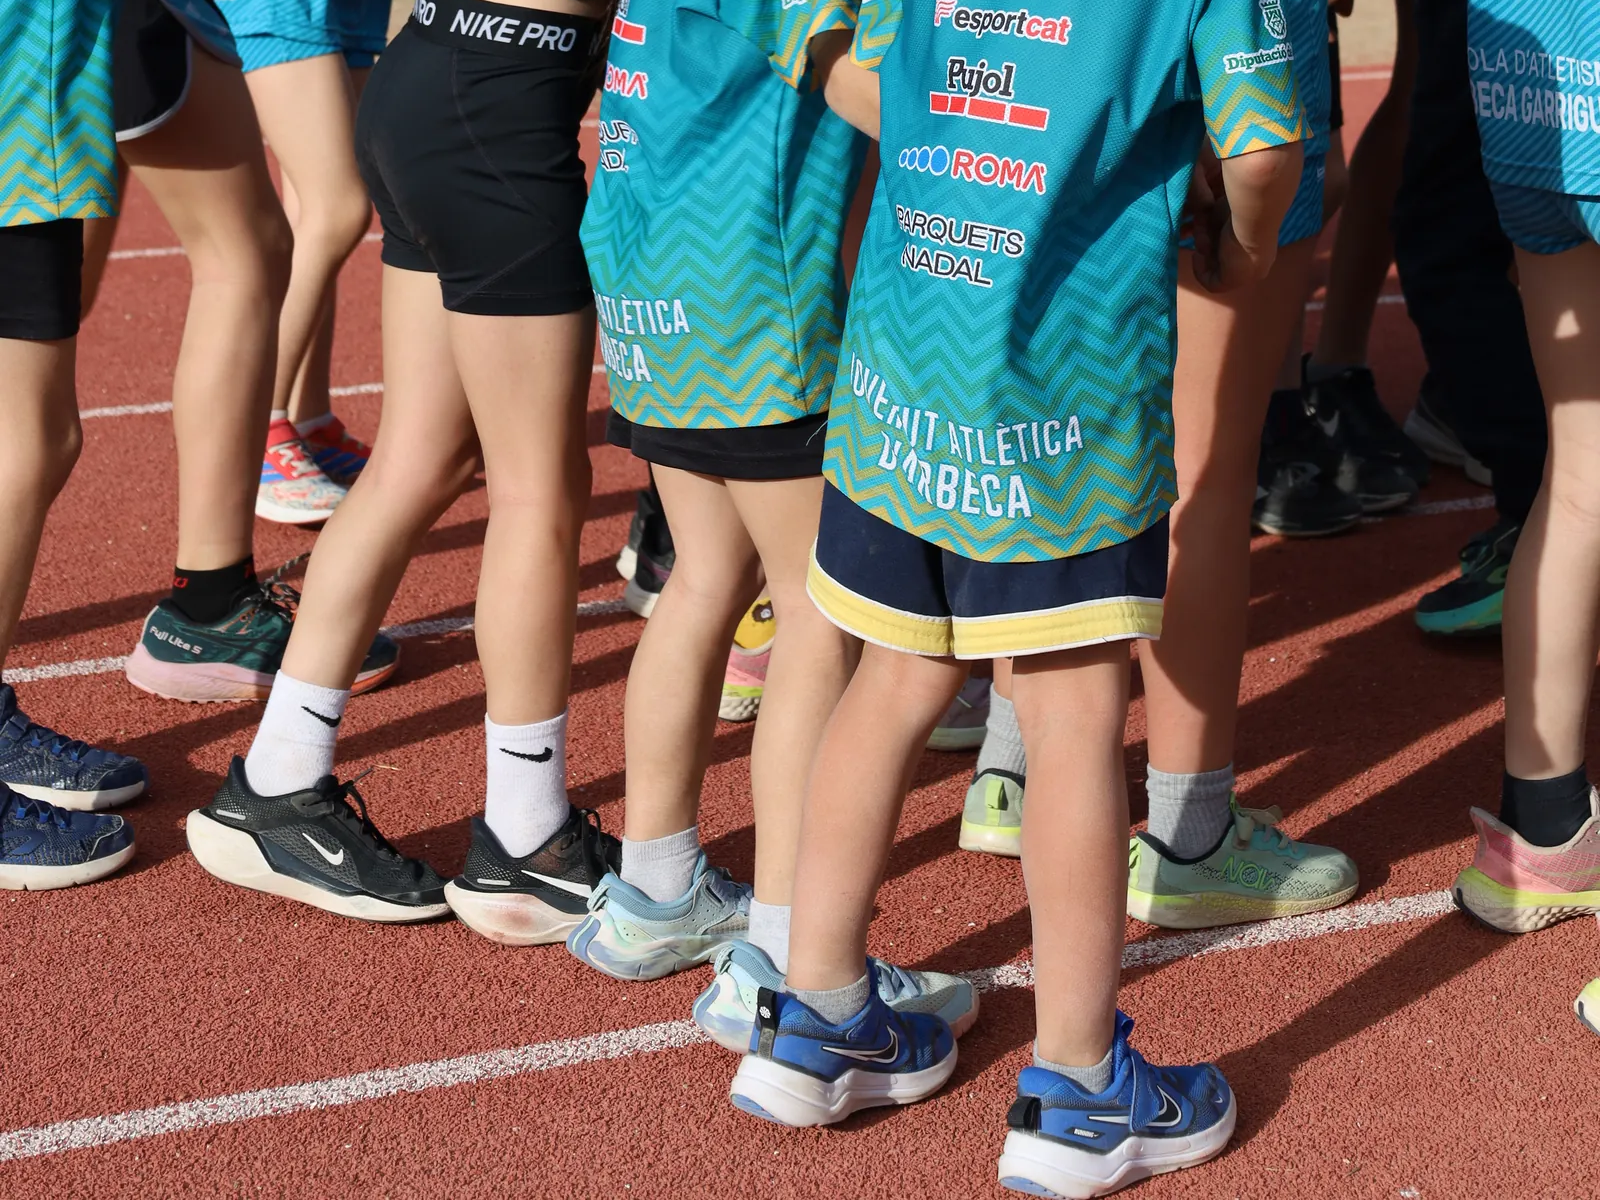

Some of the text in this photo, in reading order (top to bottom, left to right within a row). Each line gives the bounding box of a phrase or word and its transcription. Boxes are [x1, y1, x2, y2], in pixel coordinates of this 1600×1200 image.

[449, 8, 521, 44] NIKE
[518, 22, 577, 52] PRO
[953, 6, 1070, 44] esportcat
[1226, 43, 1287, 70] Diputació
[947, 58, 1014, 97] Pujol
[897, 207, 1024, 255] PARQUETS
[902, 246, 992, 286] NADAL
[947, 414, 1085, 467] ATLÈTICA
[168, 634, 191, 651] Lite
